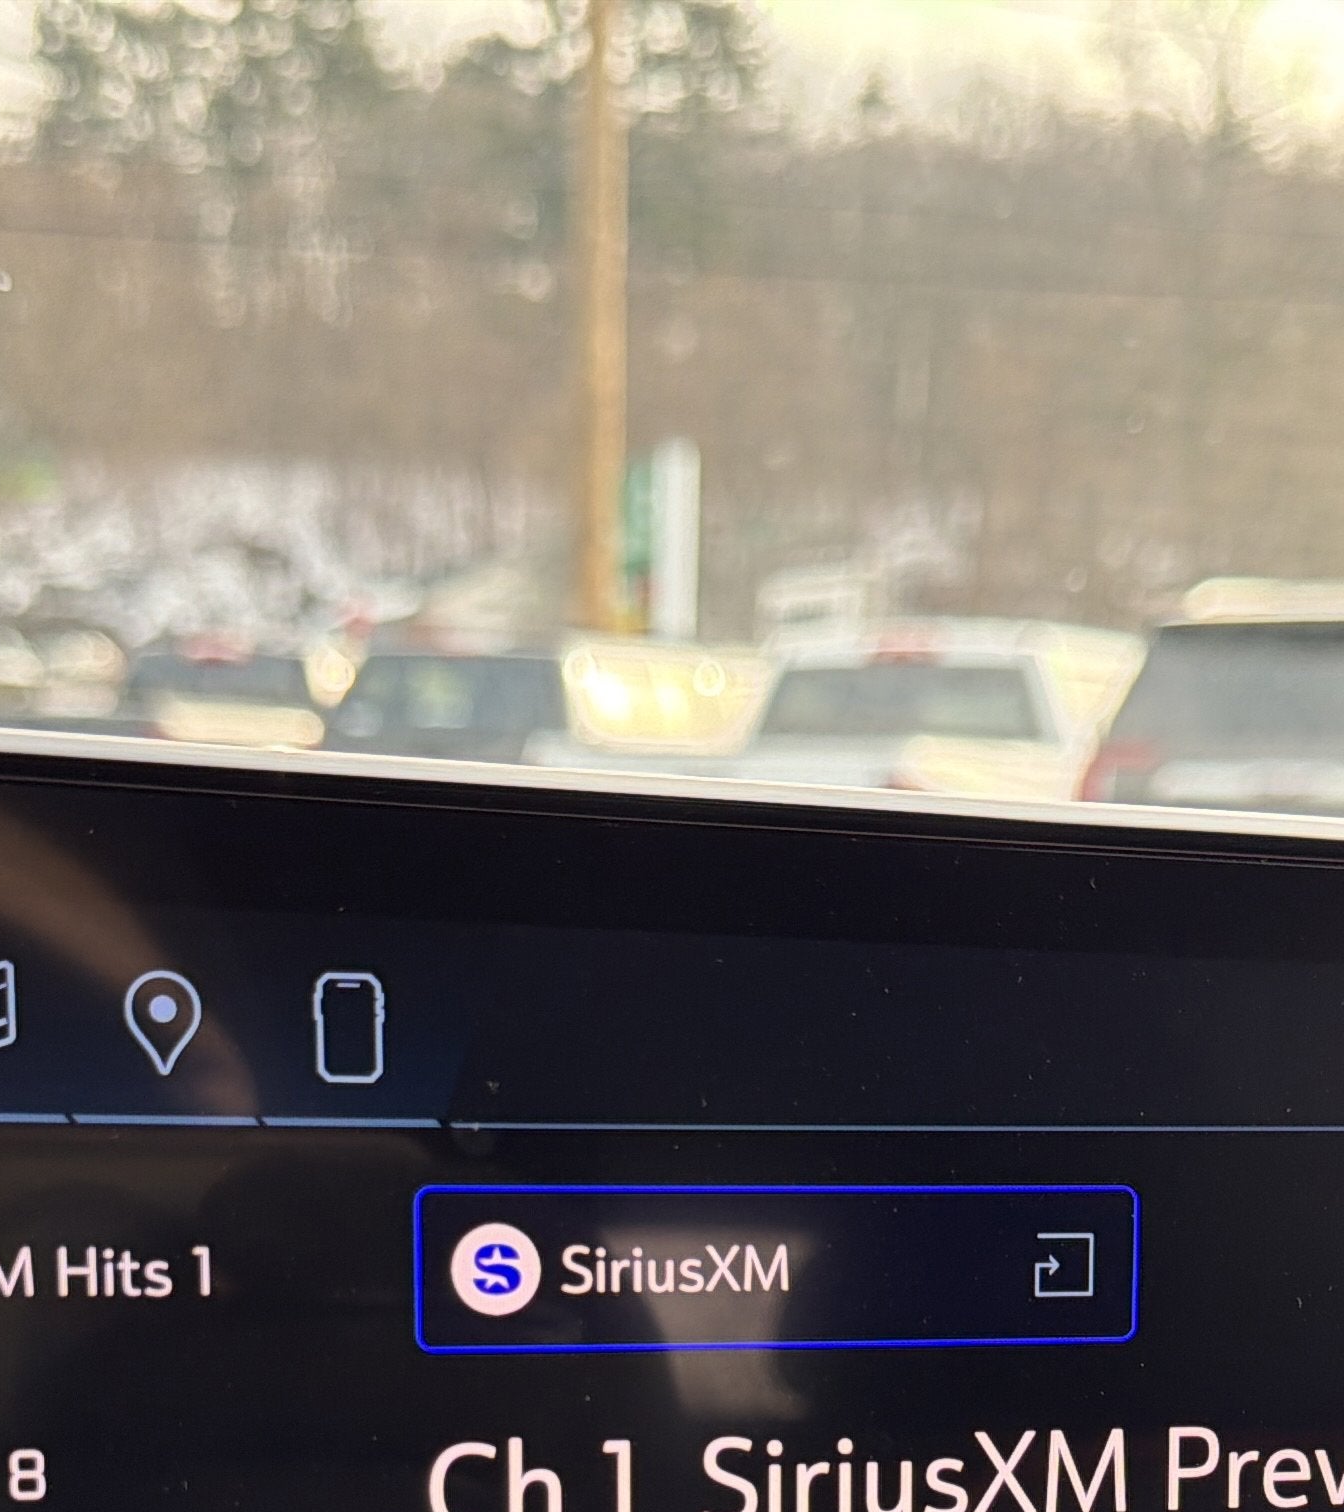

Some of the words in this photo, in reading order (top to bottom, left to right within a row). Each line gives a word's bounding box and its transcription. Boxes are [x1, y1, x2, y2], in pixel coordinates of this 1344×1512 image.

[56, 1246, 173, 1298] Hits
[191, 1245, 211, 1297] 1
[561, 1244, 789, 1295] SiriusXM
[8, 1448, 47, 1501] 8
